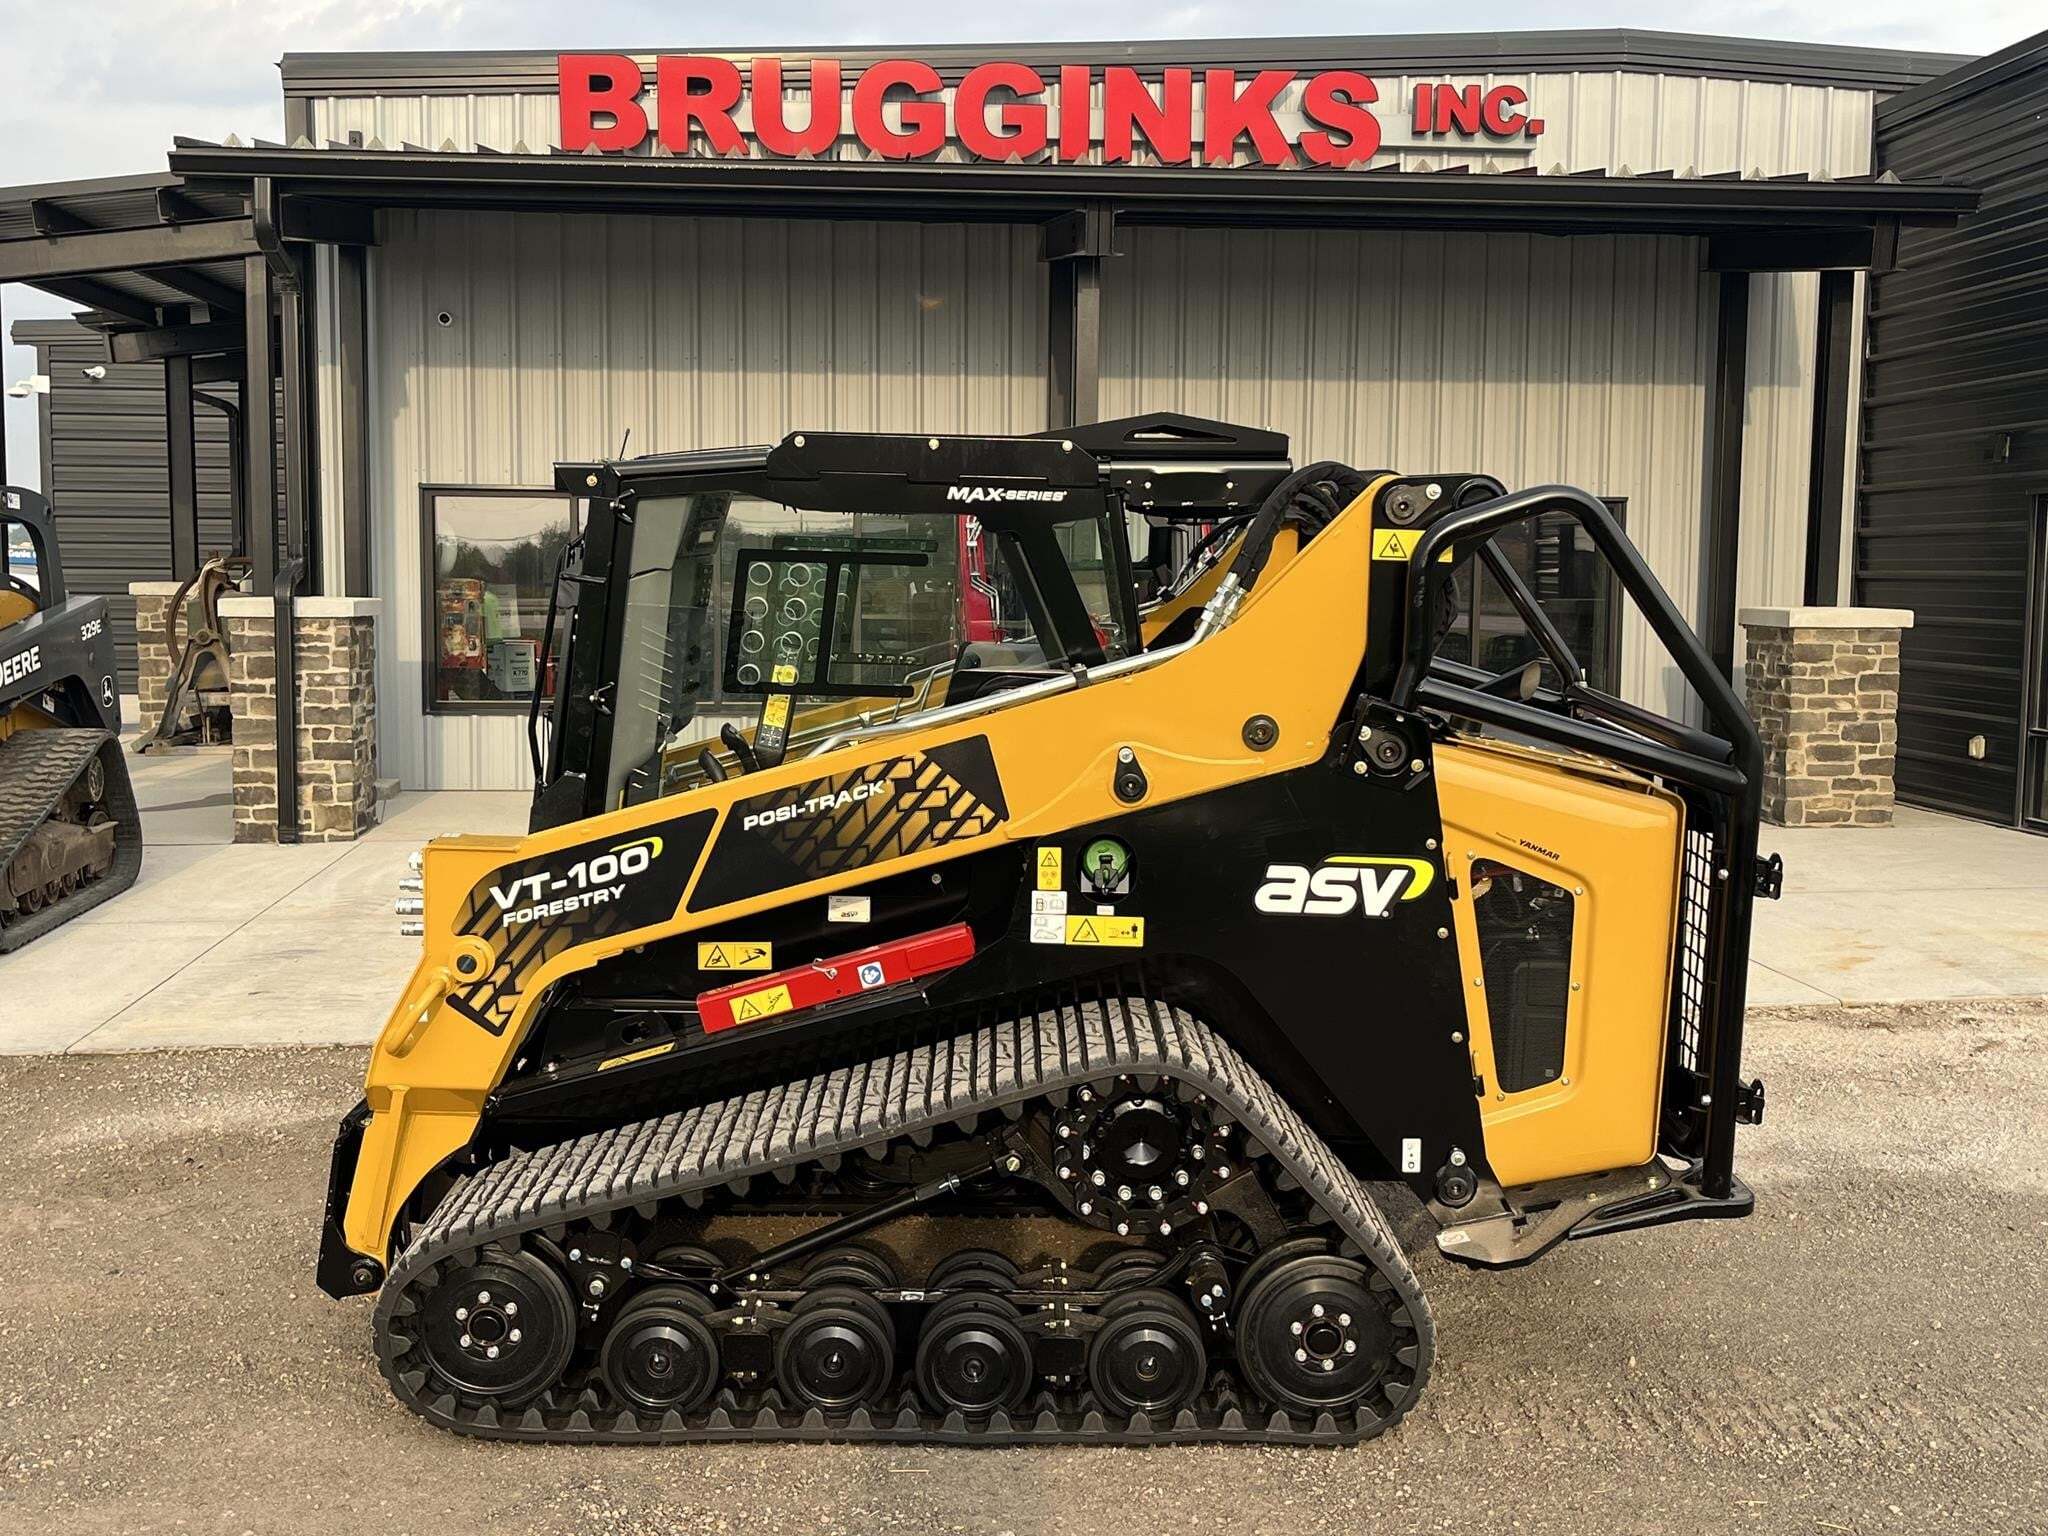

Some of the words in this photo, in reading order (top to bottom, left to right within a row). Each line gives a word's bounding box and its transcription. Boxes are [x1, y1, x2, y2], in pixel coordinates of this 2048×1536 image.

[557, 54, 1382, 168] BRUGGINKS
[1411, 83, 1545, 136] INC.
[946, 486, 1067, 503] MAX-SERIES
[80, 618, 102, 641] 329E
[743, 781, 885, 831] POSI-TRACK
[1519, 838, 1560, 861] YANMAR
[488, 846, 651, 911] VT-100
[502, 883, 627, 928] FORESTRY
